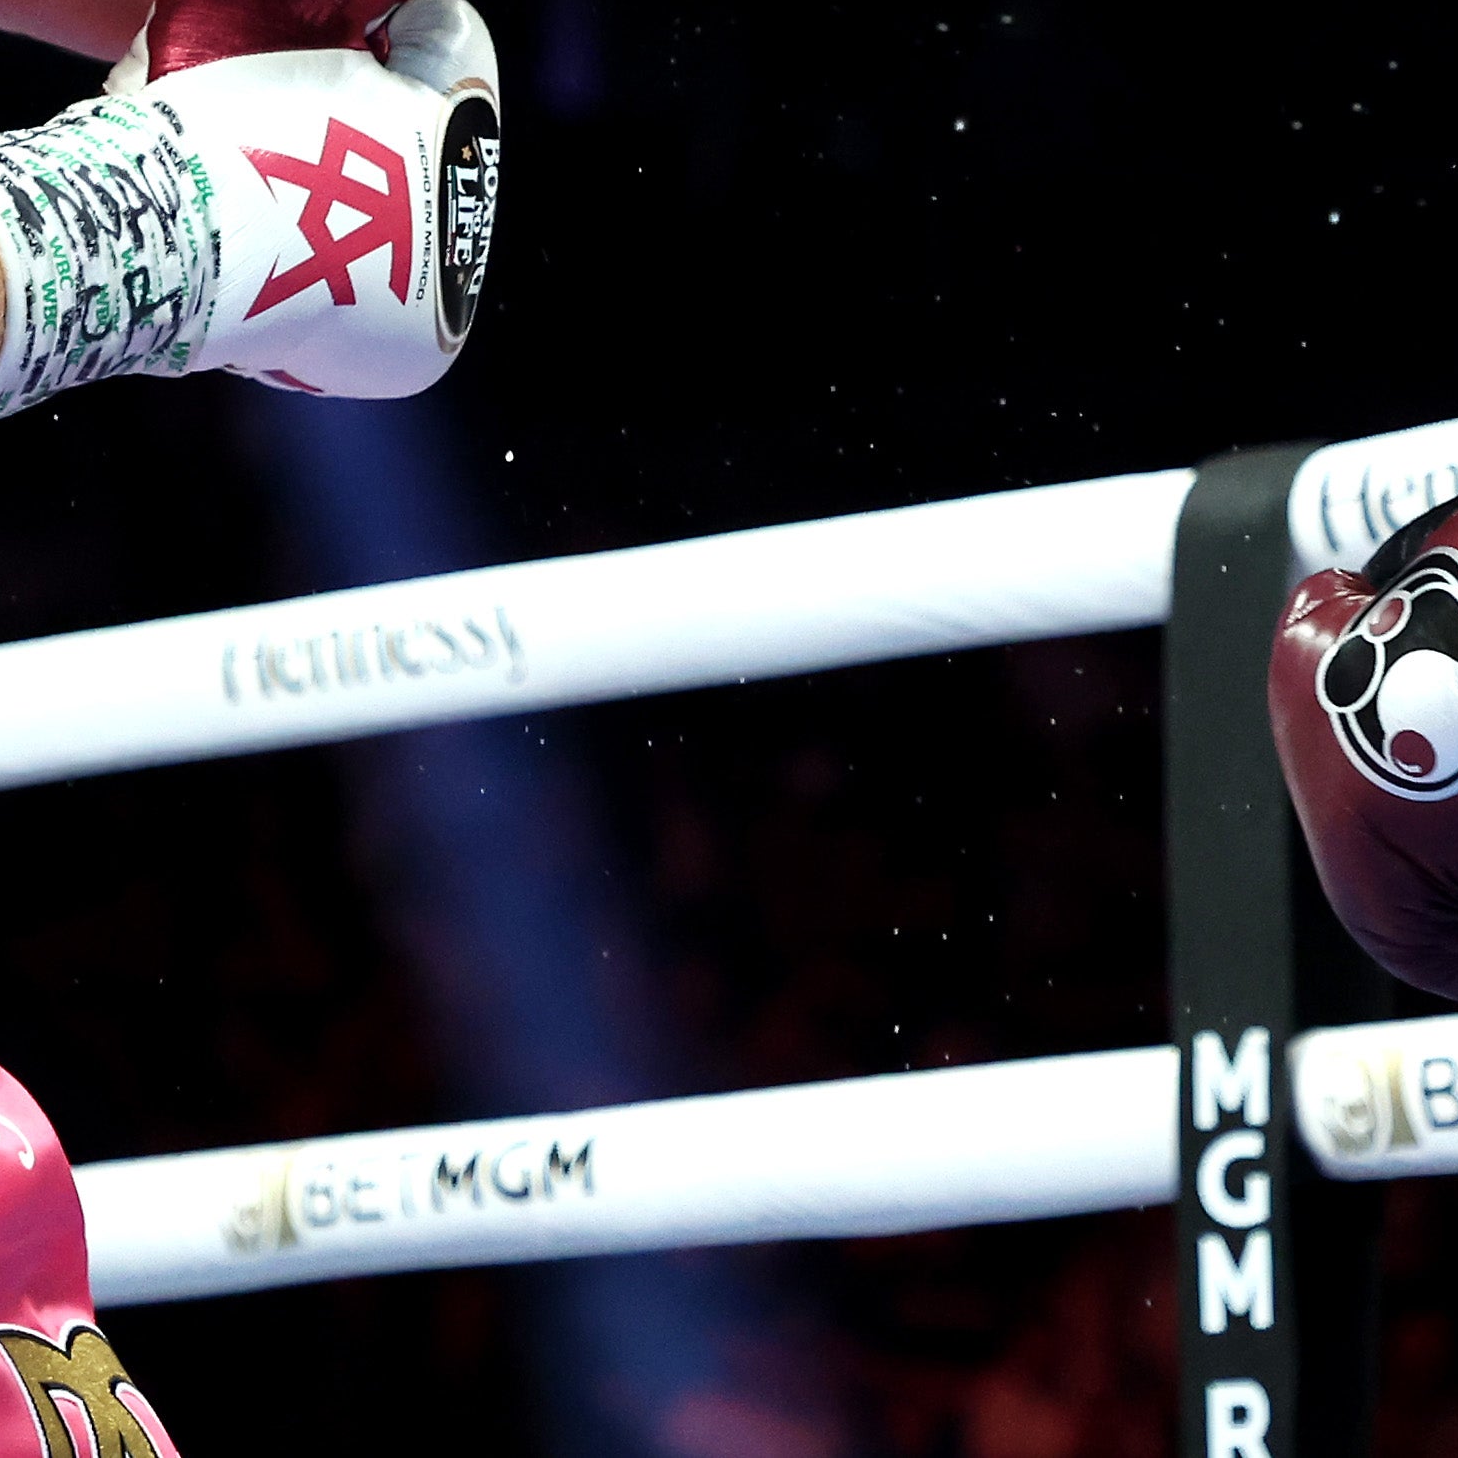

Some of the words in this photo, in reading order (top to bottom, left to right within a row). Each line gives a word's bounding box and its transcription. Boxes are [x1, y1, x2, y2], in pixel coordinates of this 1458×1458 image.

[414, 130, 433, 193] HECHO
[423, 198, 433, 226] EN
[452, 166, 480, 268] LIFE
[465, 136, 500, 296] BOXING
[471, 199, 485, 235] NO
[49, 235, 76, 291] WBC
[42, 279, 58, 335] WBC
[302, 1137, 596, 1227] BETMGM
[1191, 1025, 1275, 1336] MGM
